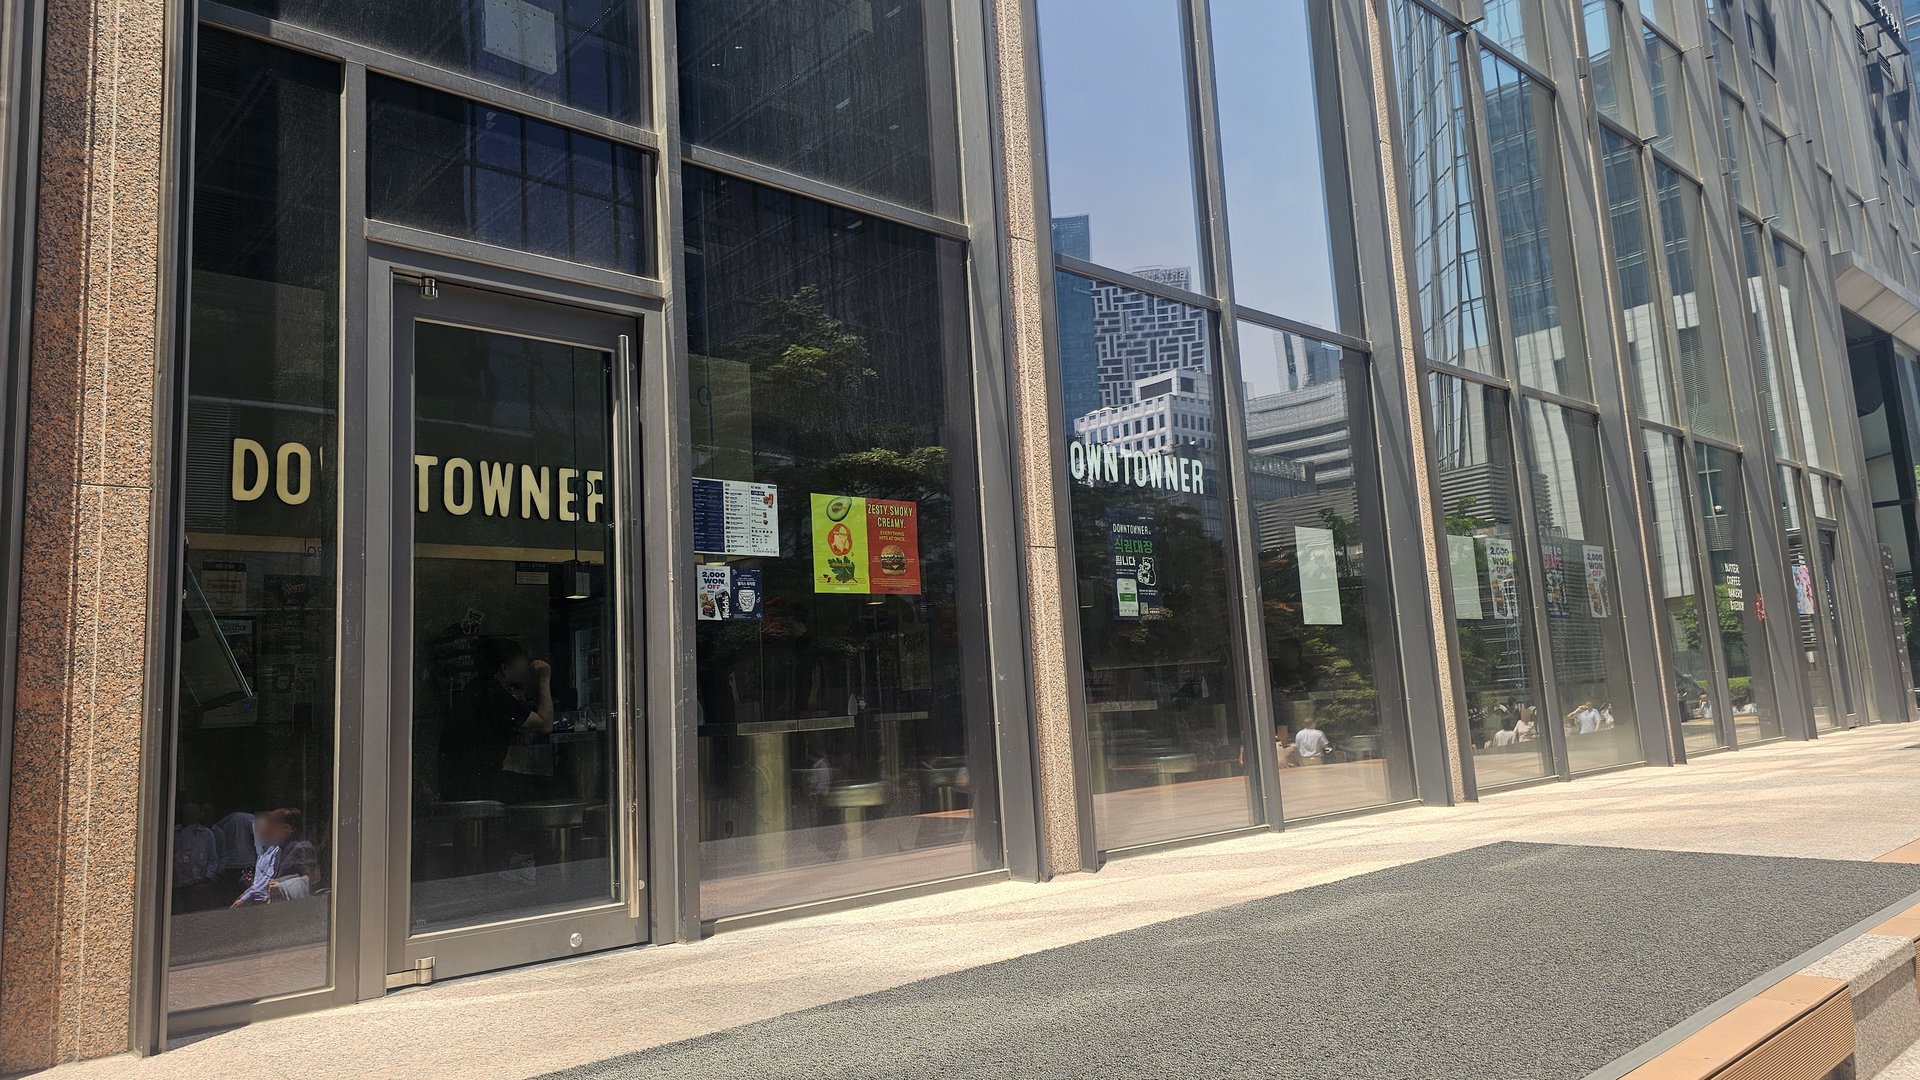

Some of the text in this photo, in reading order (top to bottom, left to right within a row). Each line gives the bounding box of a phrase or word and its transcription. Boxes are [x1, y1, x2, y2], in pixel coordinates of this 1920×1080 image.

[877, 517, 906, 529] CREAMY.
[1114, 538, 1153, 554] 식권대장
[1115, 555, 1136, 566] 됩니다
[1588, 562, 1603, 570] WON
[1726, 575, 1742, 586] COFFEE
